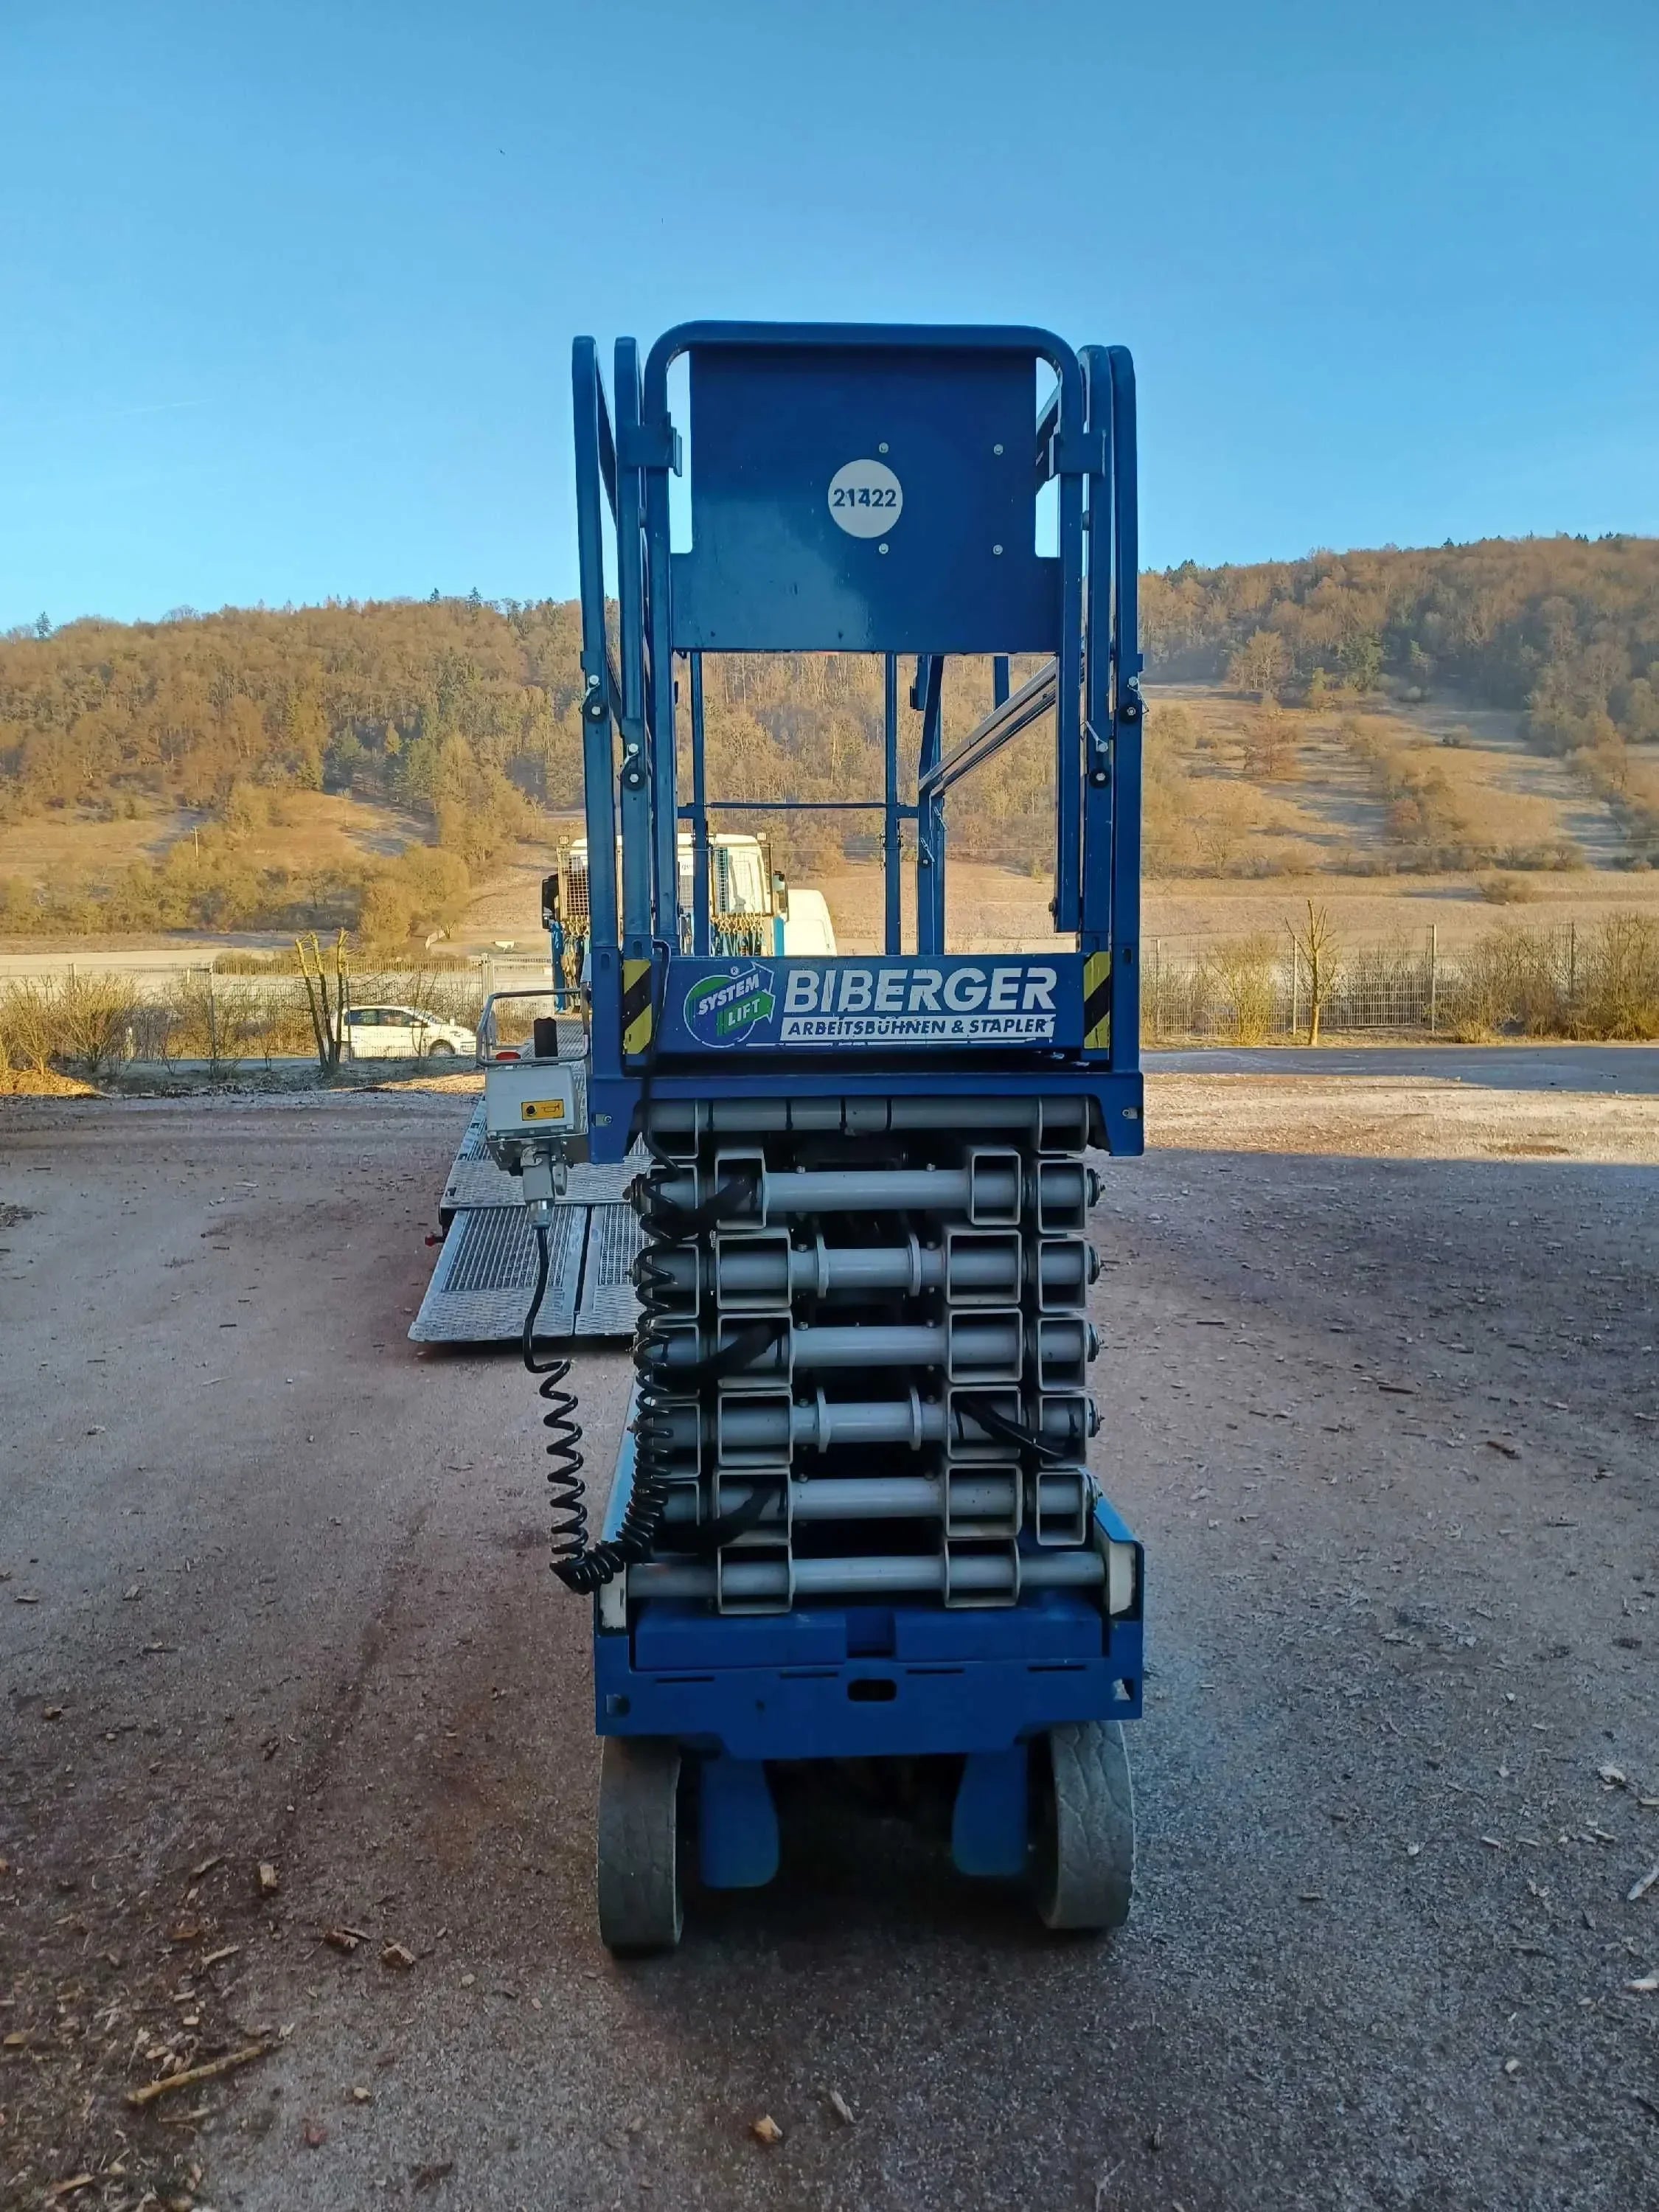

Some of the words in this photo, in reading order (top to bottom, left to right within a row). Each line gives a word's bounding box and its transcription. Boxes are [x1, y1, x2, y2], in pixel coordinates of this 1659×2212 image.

[832, 488, 897, 507] 21422
[698, 973, 759, 1015] SYSTEM
[783, 967, 1057, 1013] BIBERGER
[728, 998, 760, 1026] LIFT
[787, 1020, 946, 1035] ARBEITSBÜHNEN
[951, 1019, 964, 1034] &
[970, 1018, 1048, 1033] STAPLER
